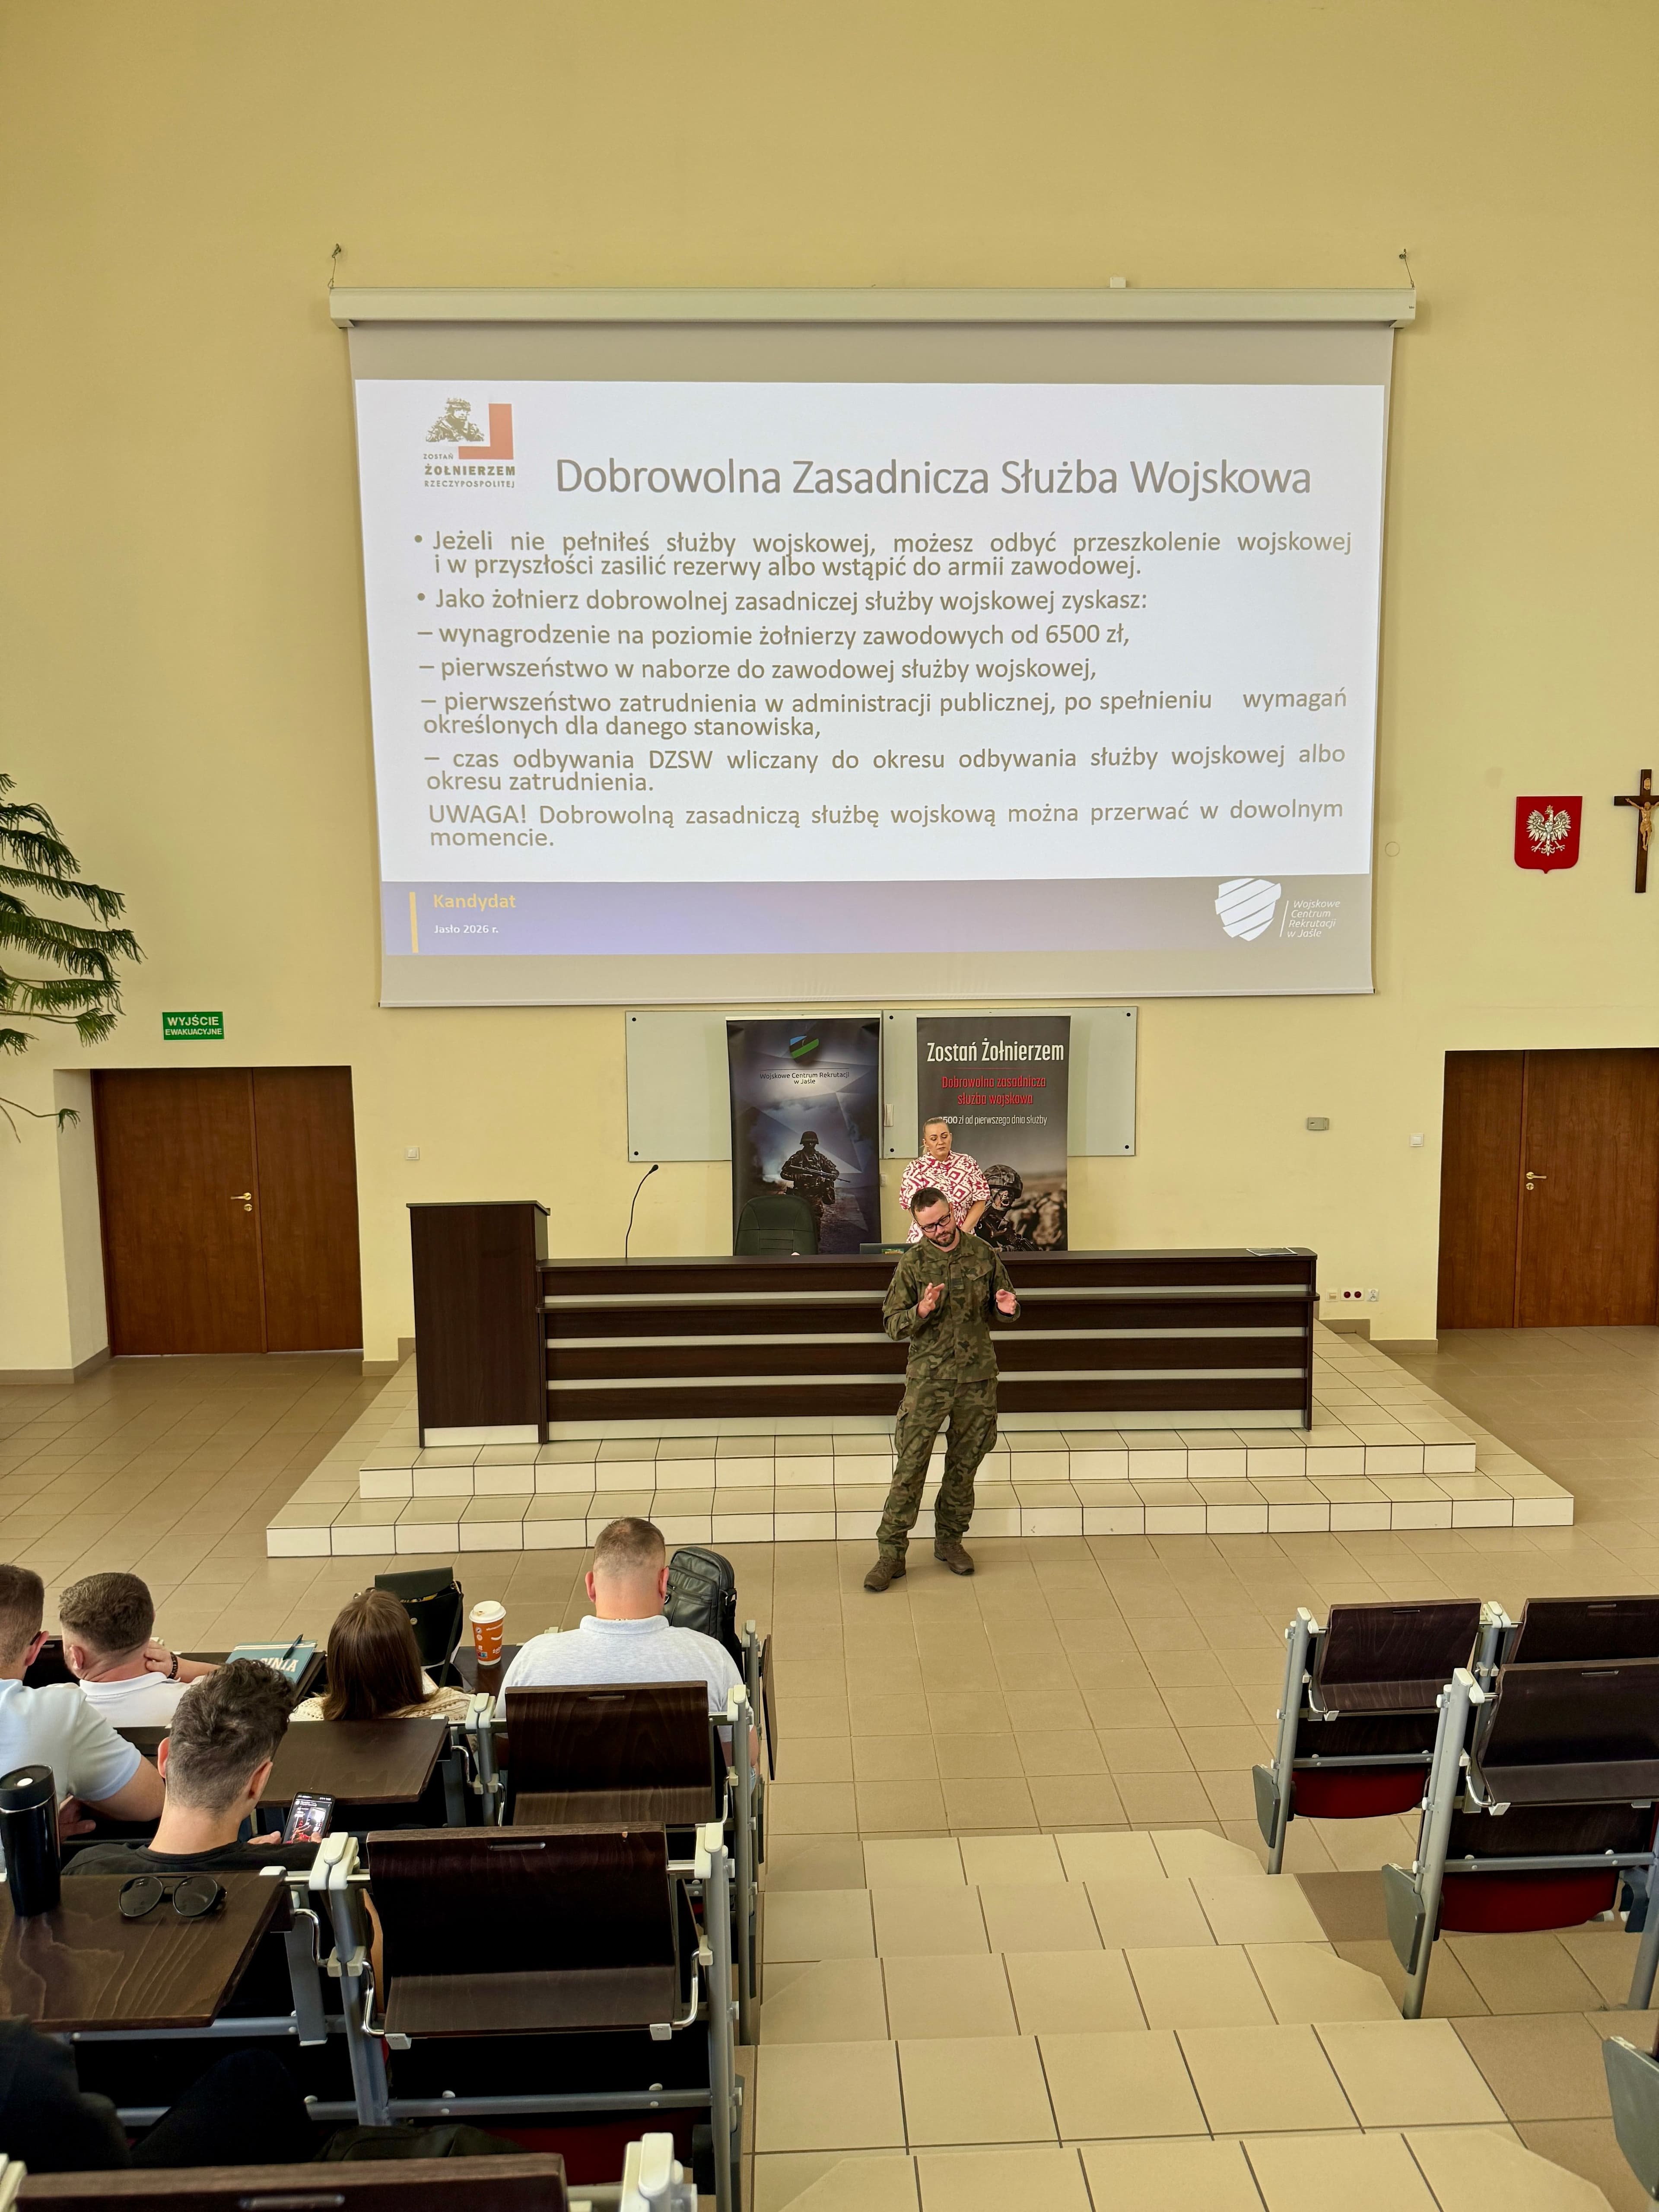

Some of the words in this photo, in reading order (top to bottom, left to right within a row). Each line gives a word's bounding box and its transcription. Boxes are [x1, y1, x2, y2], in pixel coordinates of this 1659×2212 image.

[425, 463, 515, 476] ŻOŁNIERZEM
[424, 480, 515, 489] RZECZYPOSPOLITEJ
[557, 458, 780, 493] Dobrowolna
[793, 459, 988, 494] Zasadnicza
[1001, 459, 1116, 493] Służba
[1130, 459, 1310, 501] Wojskowa
[432, 530, 493, 550] Jeżeli
[511, 531, 545, 551] nie
[563, 531, 650, 556] pełniłeś
[667, 531, 736, 557] służby
[752, 532, 875, 558] wojskowej,
[894, 533, 973, 553] możesz
[990, 531, 1056, 557] odbyć
[1074, 531, 1220, 557] przeszkolenie
[1237, 531, 1351, 555] wojskowej
[435, 554, 440, 573] i
[447, 559, 467, 573] w
[475, 553, 593, 579] przyszłości
[601, 554, 666, 575] zasilić
[674, 560, 761, 581] rezerwy
[768, 555, 816, 576] albo
[822, 555, 906, 581] wstąpić
[913, 555, 941, 576] do
[948, 556, 1004, 576] armii
[1011, 554, 1141, 579] zawodowej.
[435, 587, 485, 608] Jako
[492, 588, 579, 609] żołnierz
[586, 588, 727, 616] dobrowolnej
[735, 590, 858, 616] zasadniczej
[865, 590, 934, 615] służby
[940, 590, 1055, 615] wojskowej
[1062, 588, 1147, 614] zyskasz:
[439, 623, 610, 648] wynagrodzenie
[618, 629, 643, 645] na
[652, 626, 752, 649] poziomie
[759, 625, 857, 650] żołnierzy
[863, 624, 1004, 649] zawodowych
[1011, 624, 1038, 644] od
[1046, 624, 1100, 644] 6500
[1106, 623, 1129, 647] zł,
[441, 656, 608, 681] pierwszeństwo
[614, 664, 634, 678] w
[642, 658, 730, 679] naborze
[737, 658, 765, 679] do
[772, 658, 894, 683] zawodowej
[901, 658, 970, 683] służby
[976, 657, 1096, 682] wojskowej,
[445, 691, 611, 715] pierwszeństwo
[619, 692, 756, 712] zatrudnienia
[764, 698, 784, 713] w
[792, 693, 931, 717] administracji
[940, 691, 1055, 717] publicznej,
[1065, 696, 1092, 715] po
[1100, 690, 1211, 715] spełnieniu
[1243, 686, 1347, 712] wymagań
[423, 713, 558, 739] określonych
[565, 715, 598, 735] dla
[606, 715, 687, 740] danego
[694, 716, 820, 739] stanowiska,
[453, 753, 499, 768] czas
[513, 748, 634, 773] odbywania
[649, 750, 713, 769] DZSW
[726, 749, 819, 774] wliczany
[832, 749, 859, 769] do
[873, 749, 944, 769] okresu
[959, 748, 1076, 772] odbywania
[1090, 746, 1158, 770] służby
[1171, 744, 1285, 769] wojskowej
[1299, 743, 1345, 763] albo
[426, 770, 501, 790] okresu
[509, 771, 654, 791] zatrudnienia.
[429, 804, 526, 823] UWAGA!
[540, 804, 674, 829] Dobrowolną
[686, 805, 801, 829] zasadniczą
[811, 804, 879, 828] służbę
[890, 804, 996, 828] wojskową
[1008, 803, 1078, 823] można
[1091, 800, 1189, 826] przerwać
[1200, 805, 1219, 819] w
[1230, 798, 1343, 822] dowolnym
[431, 828, 554, 846] momencie.
[433, 893, 515, 911] Kandydat
[1294, 899, 1340, 909] Wojskowe
[1291, 909, 1331, 918] Centrum
[434, 925, 460, 933] Jasło
[463, 925, 489, 933] 2026
[1288, 918, 1336, 929] Rekrutacji
[1297, 928, 1322, 938] Jaśle
[167, 1014, 219, 1026] WYJŚCIE
[927, 1042, 977, 1062] Zostań
[982, 1038, 1064, 1061] Żołnierzem
[941, 1075, 994, 1088] Dobrowolna
[997, 1075, 1046, 1087] zasadnicza
[988, 1092, 1033, 1106] wojskowa
[966, 1115, 973, 1124] od
[975, 1116, 1010, 1126] pierwszego
[1011, 1115, 1025, 1124] dnia
